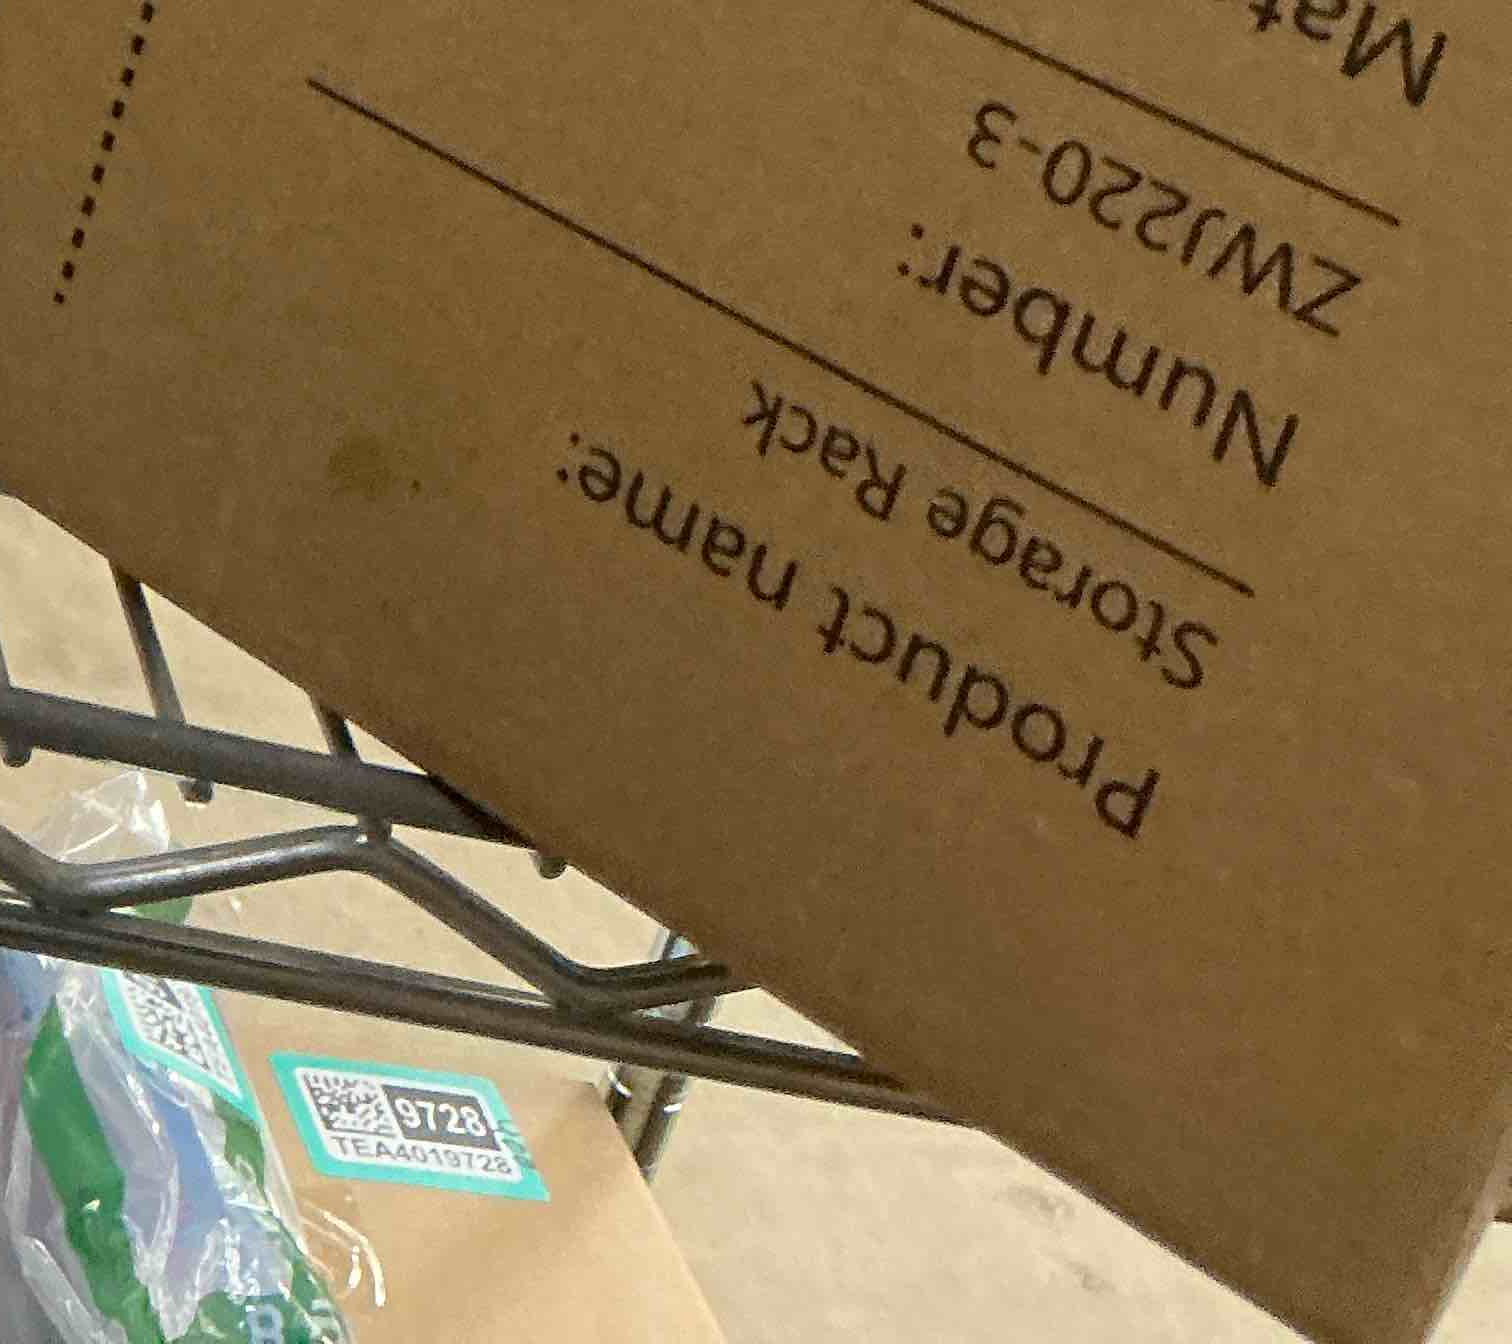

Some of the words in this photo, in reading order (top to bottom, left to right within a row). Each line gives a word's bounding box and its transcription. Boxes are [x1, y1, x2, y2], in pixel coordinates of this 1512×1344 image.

[966, 99, 1363, 338] ZWJ220-3
[740, 379, 906, 522] Rack
[896, 222, 1299, 490] Number:
[555, 431, 799, 611] name:
[926, 488, 1219, 690] Storage
[816, 585, 1160, 840] Product
[331, 1134, 514, 1176] TEA4019728
[394, 1095, 488, 1135] 9728
